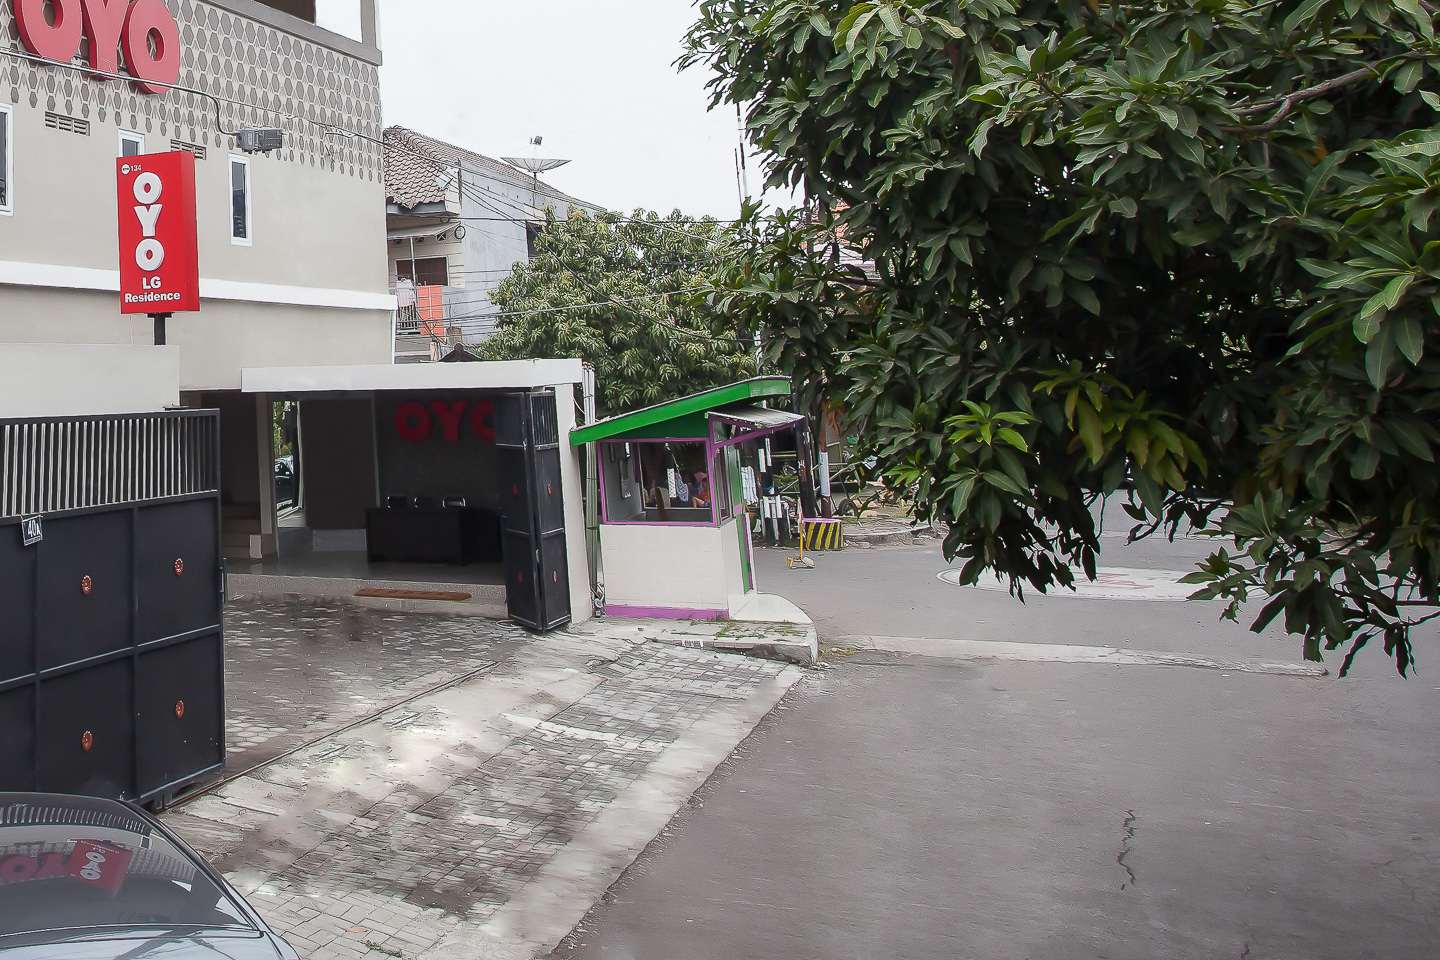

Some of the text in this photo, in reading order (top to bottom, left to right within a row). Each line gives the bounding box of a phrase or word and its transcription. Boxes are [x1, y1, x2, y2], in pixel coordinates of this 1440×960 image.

[133, 171, 165, 271] OYO
[142, 276, 161, 289] LG
[124, 291, 181, 303] Residence
